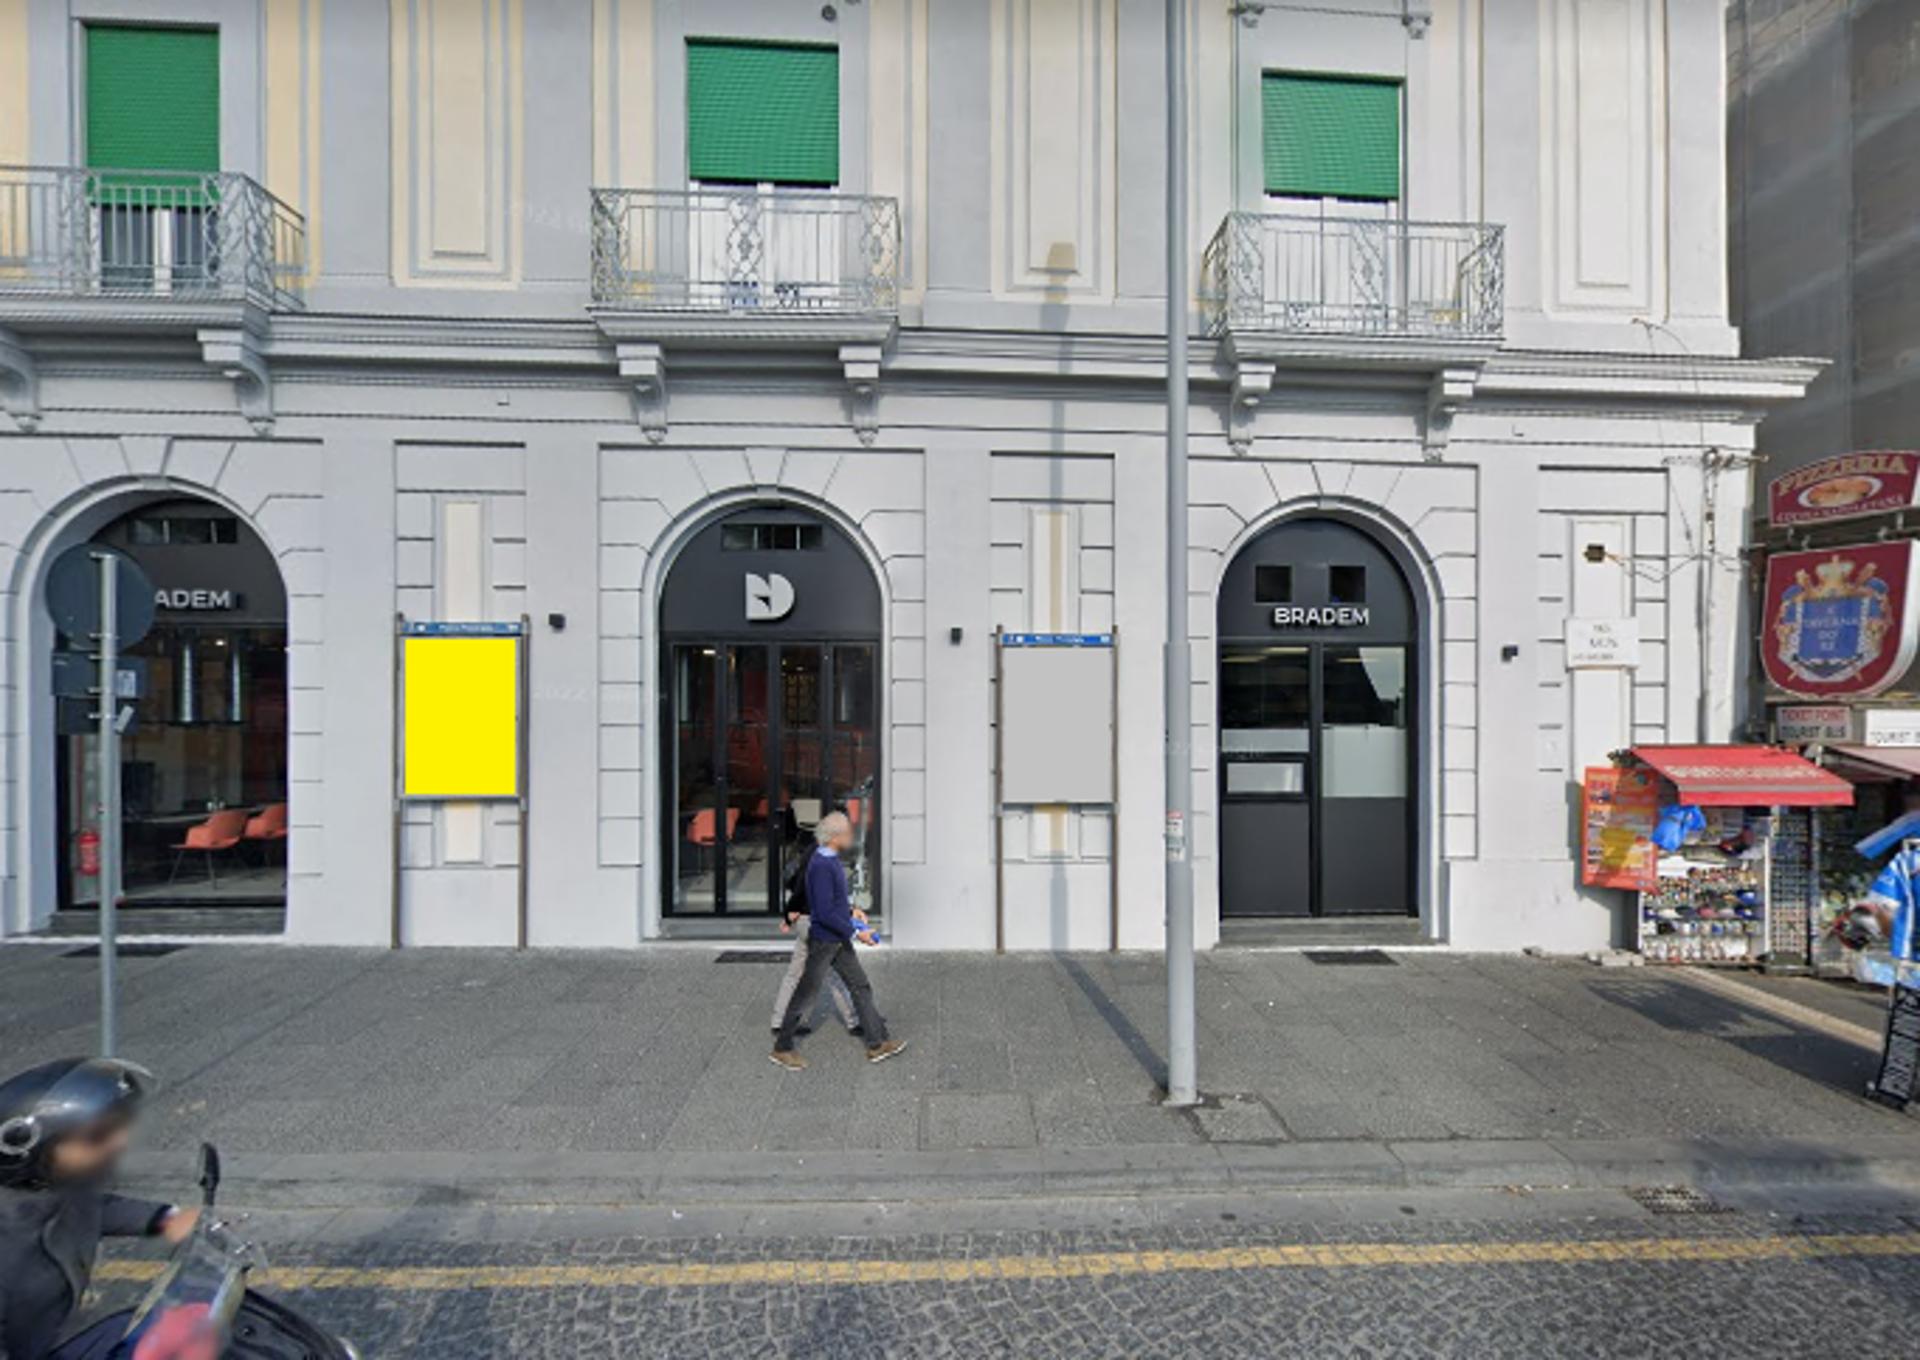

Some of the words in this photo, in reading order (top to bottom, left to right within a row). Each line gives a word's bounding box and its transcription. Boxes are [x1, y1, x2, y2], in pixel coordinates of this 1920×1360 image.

[1778, 455, 1909, 496] PIZZERIA
[154, 589, 231, 609] ADEM
[1273, 606, 1370, 627] BRADEM
